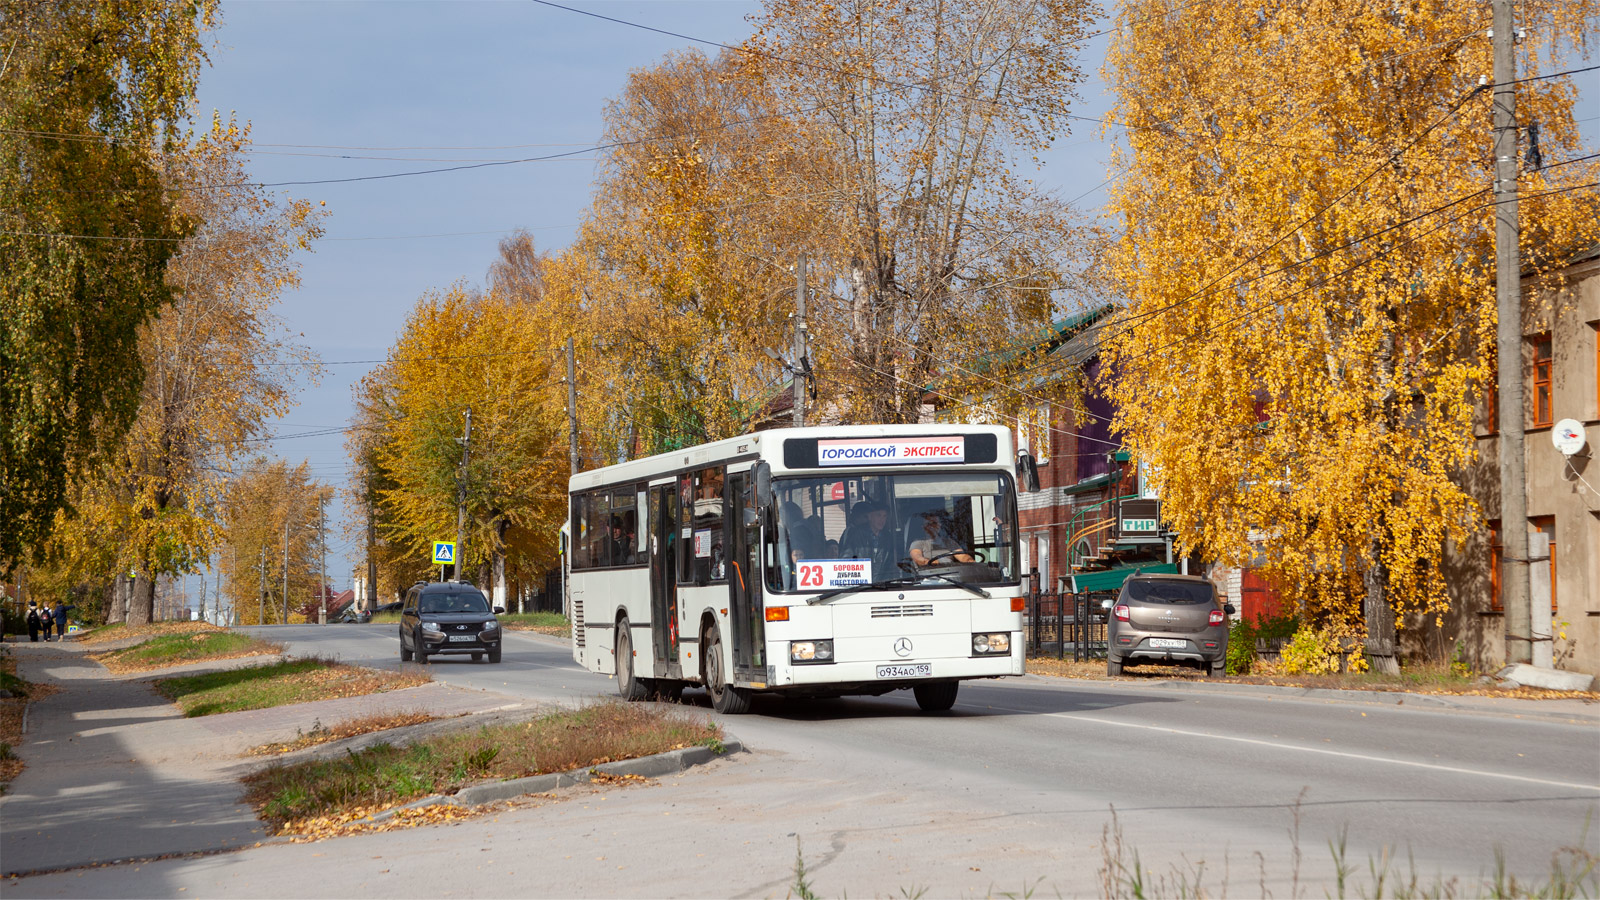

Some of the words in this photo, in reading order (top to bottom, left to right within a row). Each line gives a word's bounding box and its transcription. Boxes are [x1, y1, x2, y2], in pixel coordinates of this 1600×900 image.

[822, 445, 896, 459] ГОРОДСКОЙ
[903, 446, 960, 457] ЭКСПРЕСС
[1124, 521, 1154, 530] ТИР
[833, 564, 864, 572] БОРОВАЯ
[800, 565, 824, 586] 23
[836, 571, 861, 579] ДУБРАВА
[916, 665, 929, 673] 159
